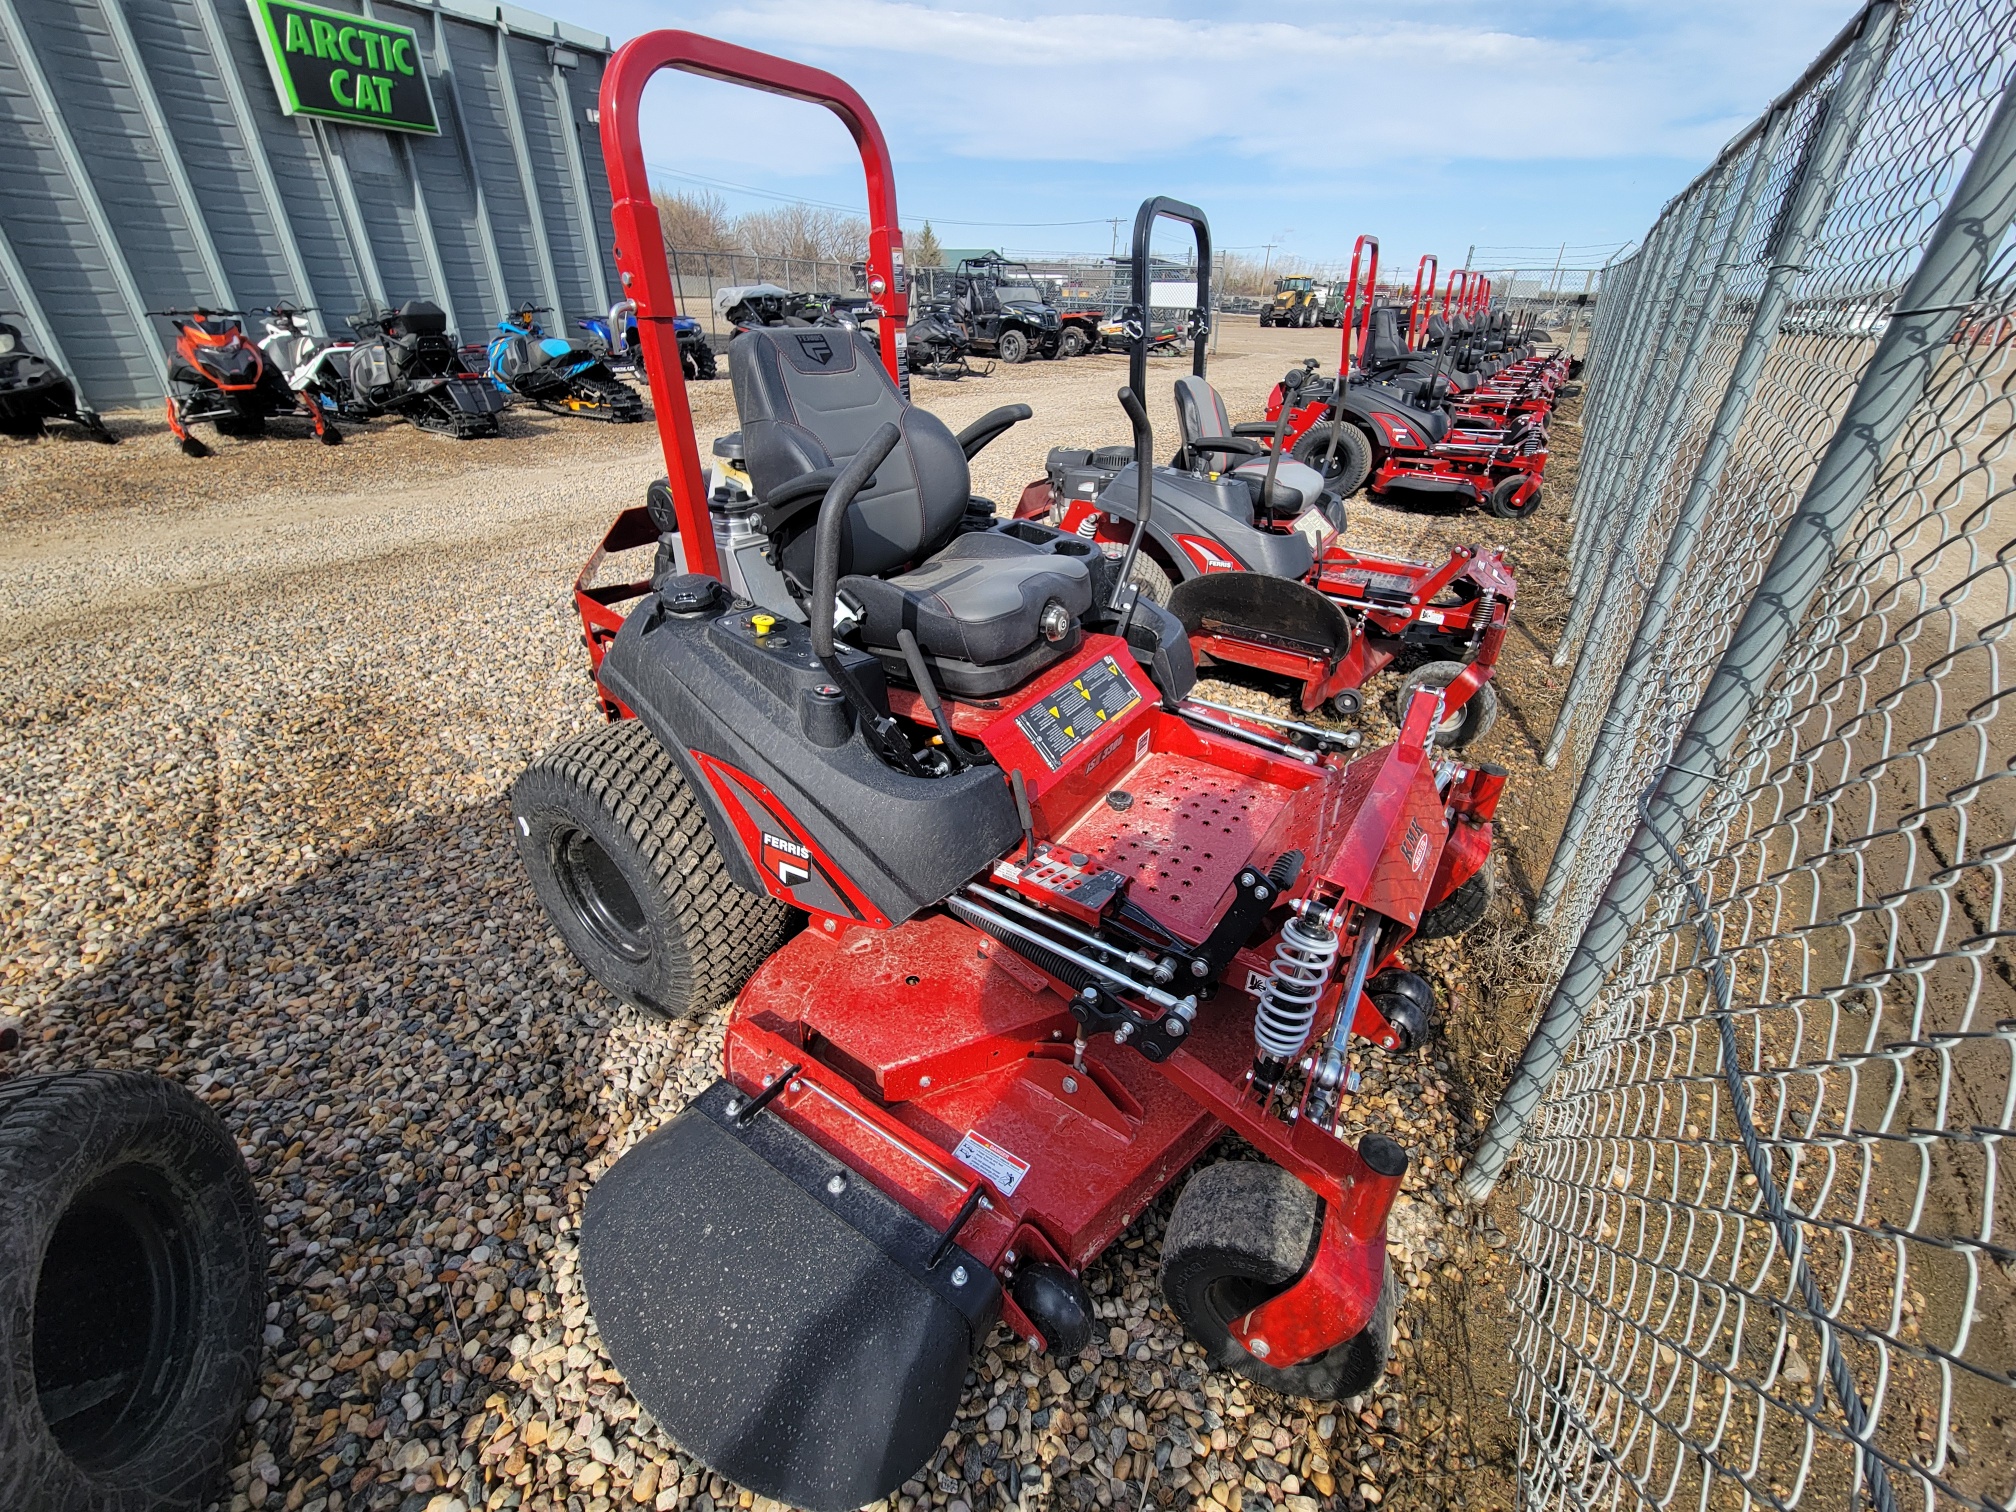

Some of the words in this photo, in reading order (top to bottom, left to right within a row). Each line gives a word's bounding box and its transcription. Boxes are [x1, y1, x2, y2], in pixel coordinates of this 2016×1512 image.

[286, 13, 414, 76] ARCTIC
[330, 68, 393, 114] CAT
[1208, 560, 1232, 568] FERRIS
[764, 833, 810, 859] FERRIS
[1400, 816, 1424, 866] KMK
[989, 1144, 1011, 1160] DANGER
